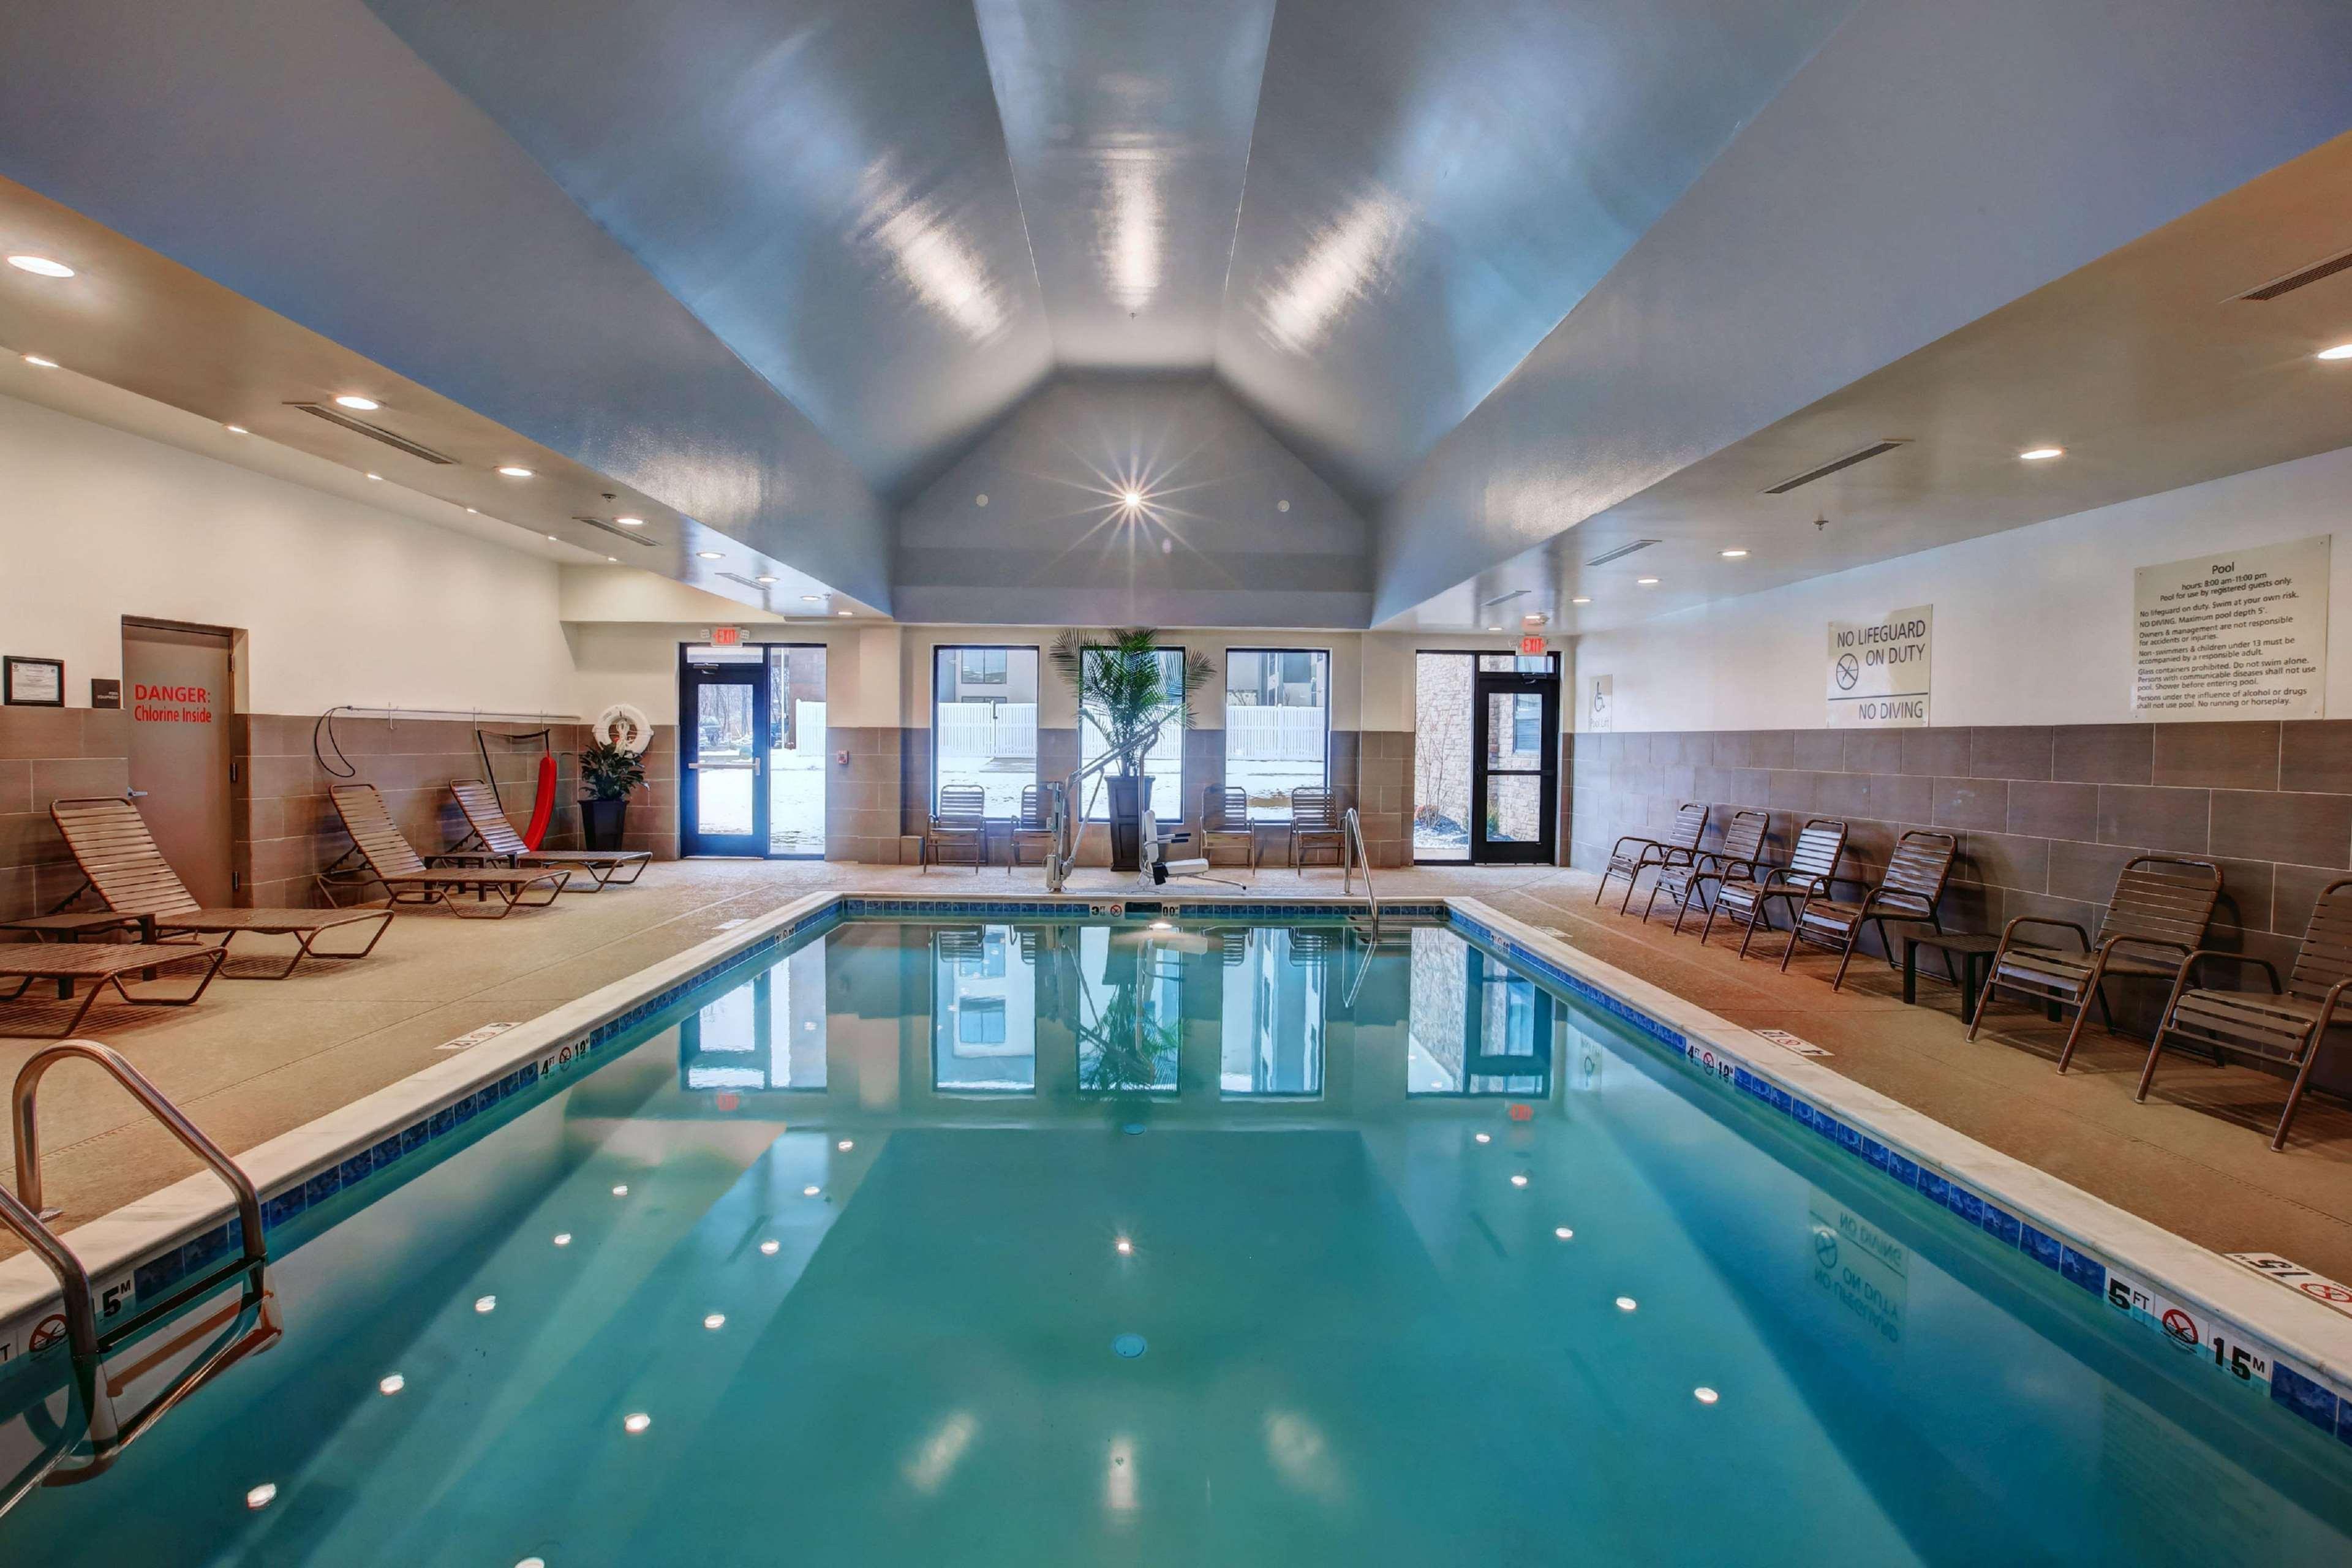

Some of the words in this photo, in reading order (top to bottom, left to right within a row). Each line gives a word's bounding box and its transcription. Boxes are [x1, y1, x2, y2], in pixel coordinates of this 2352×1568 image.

[2212, 562, 2234, 575] Pool
[2204, 579, 2219, 587] 8:00
[2211, 583, 2246, 595] registered
[2248, 581, 2272, 590] guests
[2150, 606, 2180, 616] lifeguard
[2244, 597, 2260, 606] your
[2179, 614, 2213, 623] Maximum
[2215, 611, 2231, 620] pool
[2233, 609, 2256, 617] depth
[2172, 625, 2217, 635] management
[2249, 616, 2293, 627] responsible
[717, 628, 735, 643] EXIT
[1838, 631, 1855, 648] NO
[1858, 620, 1926, 645] LIFEGUARD
[1523, 637, 1543, 653] EXIT
[2150, 637, 2180, 646] accidents
[1866, 649, 1884, 666] ON
[1889, 644, 1926, 664] DUTY
[2199, 650, 2239, 660] responsible
[2192, 663, 2231, 673] prohibited.
[2180, 671, 2231, 680] communicable
[135, 684, 211, 703] DANGER:
[2283, 687, 2307, 696] drugs
[135, 705, 179, 722] Chlorine
[183, 707, 212, 723] Inside
[1859, 703, 1876, 720] NO
[1880, 701, 1923, 719] DIVING
